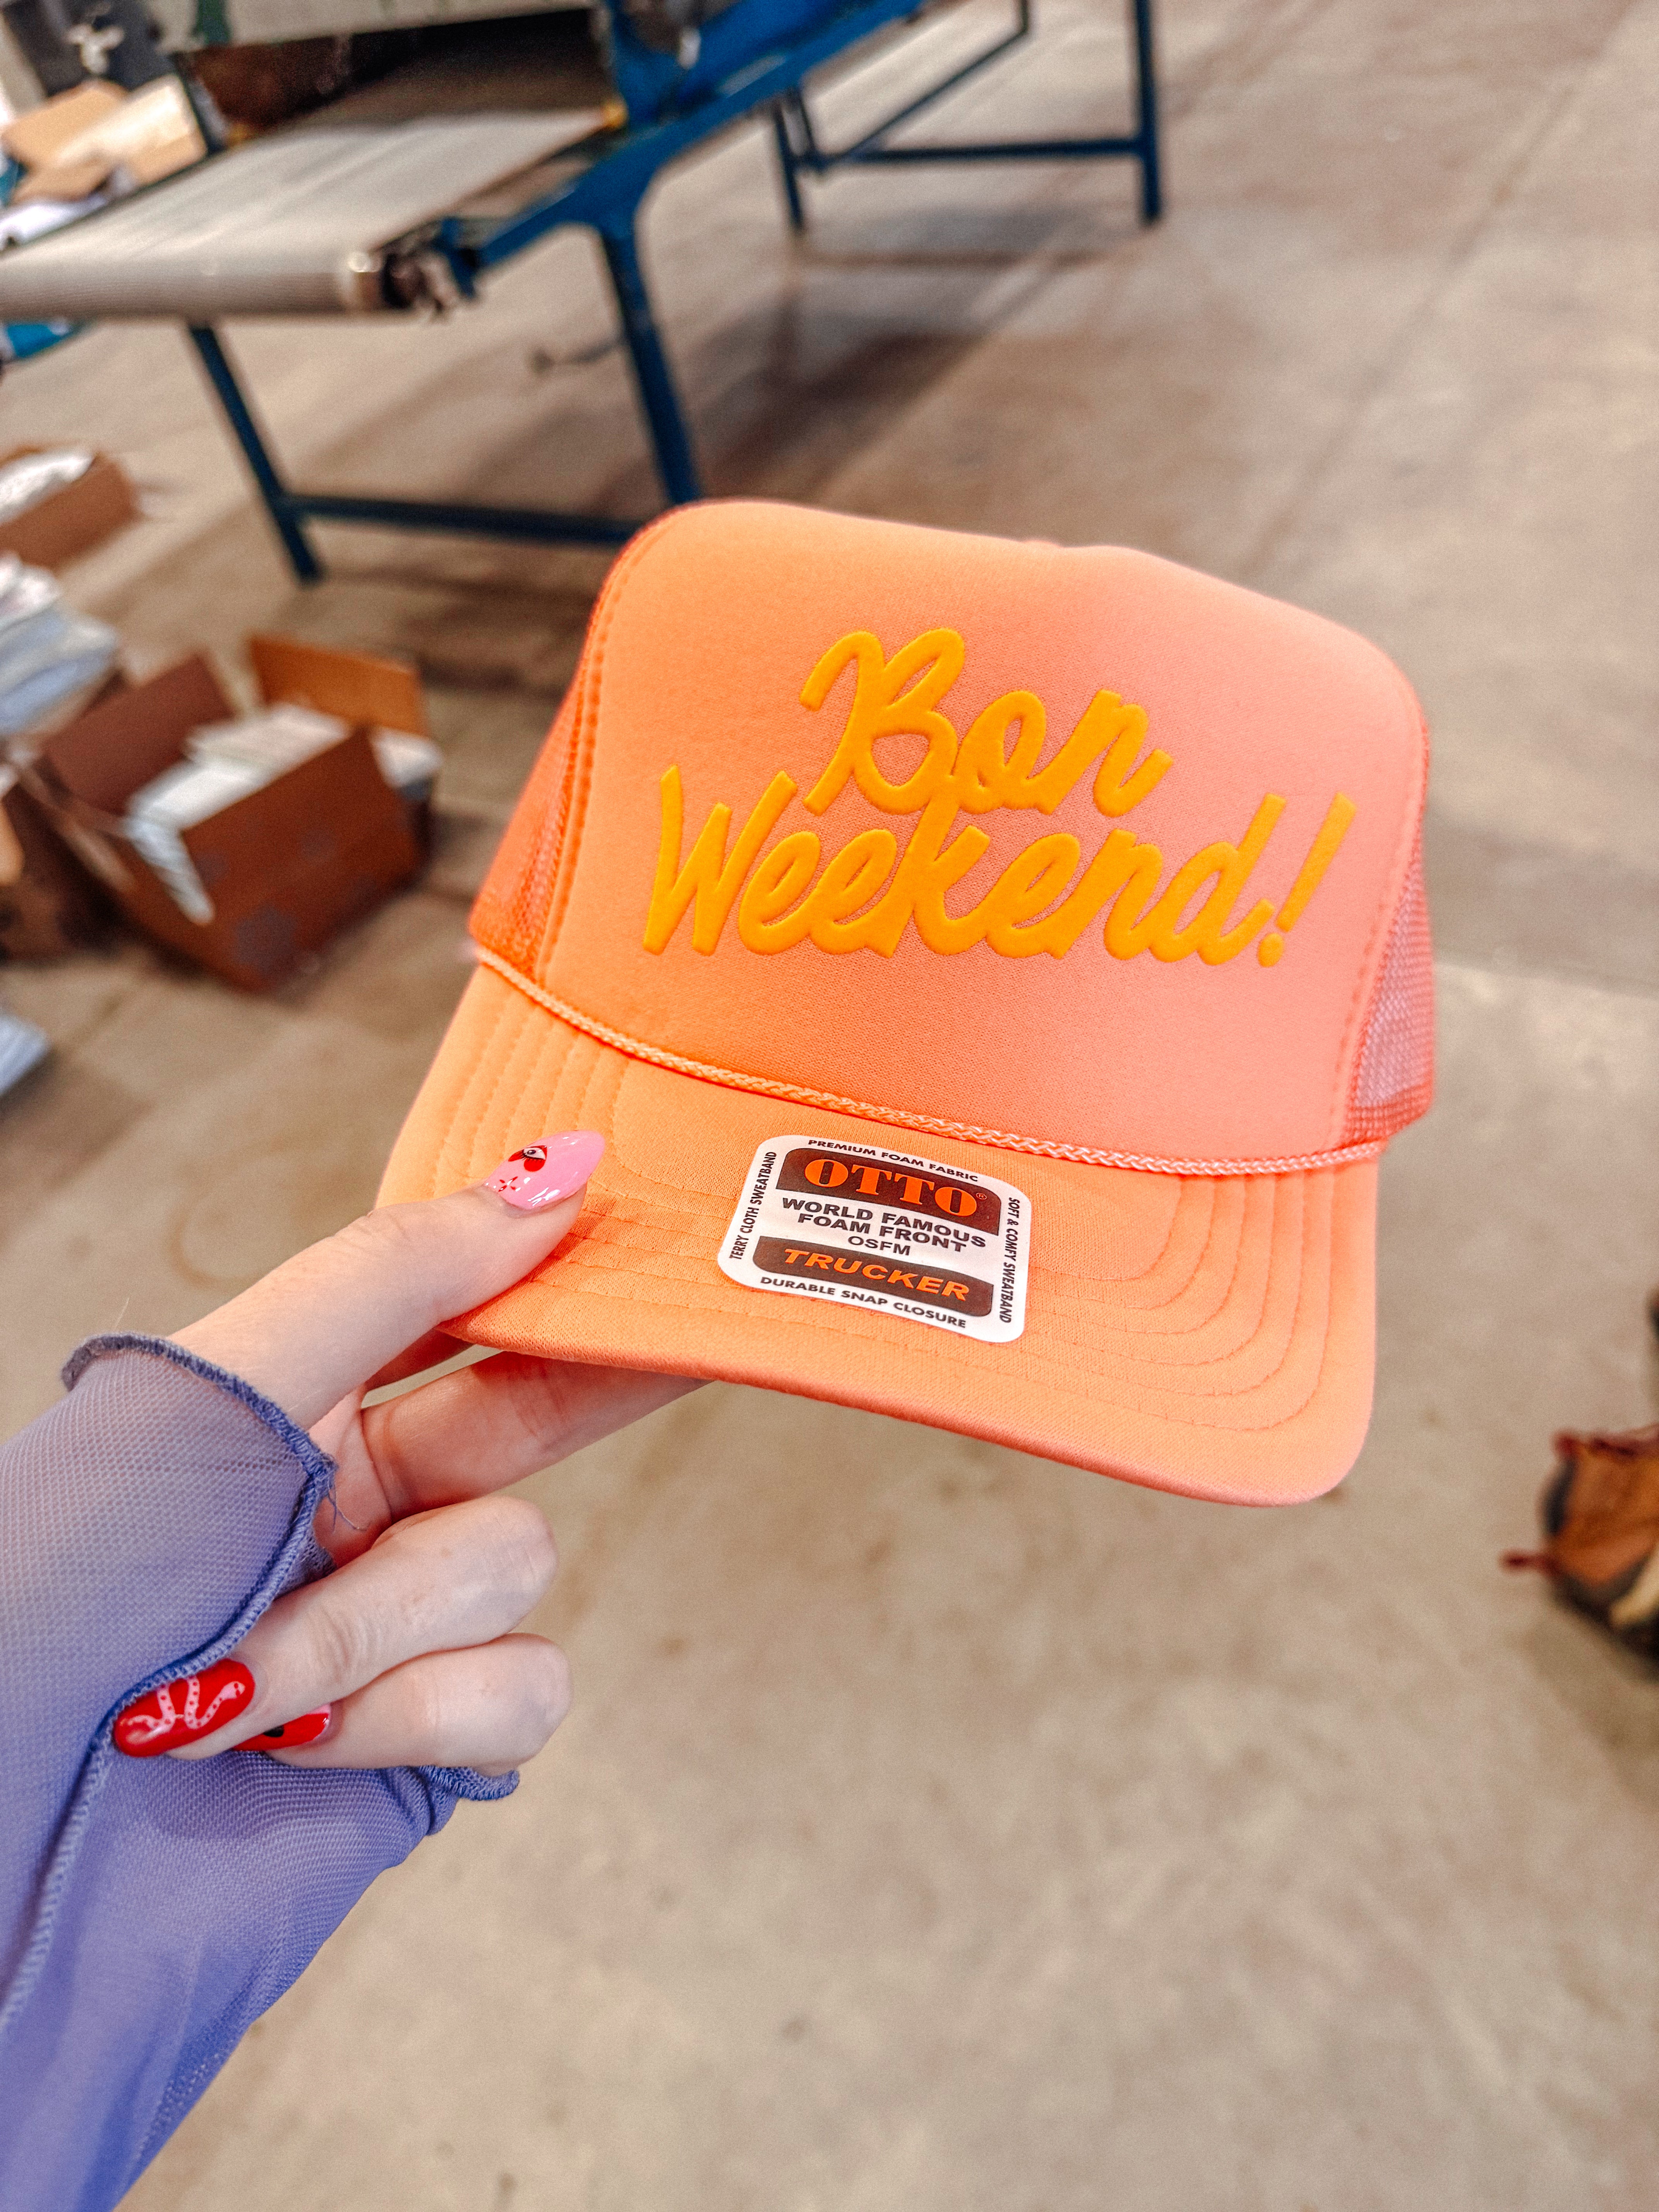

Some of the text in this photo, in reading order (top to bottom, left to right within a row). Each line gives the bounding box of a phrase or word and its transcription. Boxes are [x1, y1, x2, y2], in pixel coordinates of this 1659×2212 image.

[799, 627, 1173, 817] Bon
[642, 764, 1357, 967] Weekend!
[808, 1139, 978, 1182] PREMIUM FOAM FABRIC
[729, 1152, 777, 1260] TERRY CLOTH SWEATBAND
[782, 1197, 986, 1248] WORLD FAMOUS
[1008, 1198, 1020, 1218] SOFT
[798, 1213, 967, 1253] FOAM FRONT
[847, 1236, 910, 1256] OSFM
[1004, 1228, 1018, 1261] COMFY
[784, 1249, 969, 1301] TRUCKER
[1000, 1262, 1015, 1323] SWEATBAND
[761, 1276, 966, 1328] DURABLE SNAP CLOSURE
